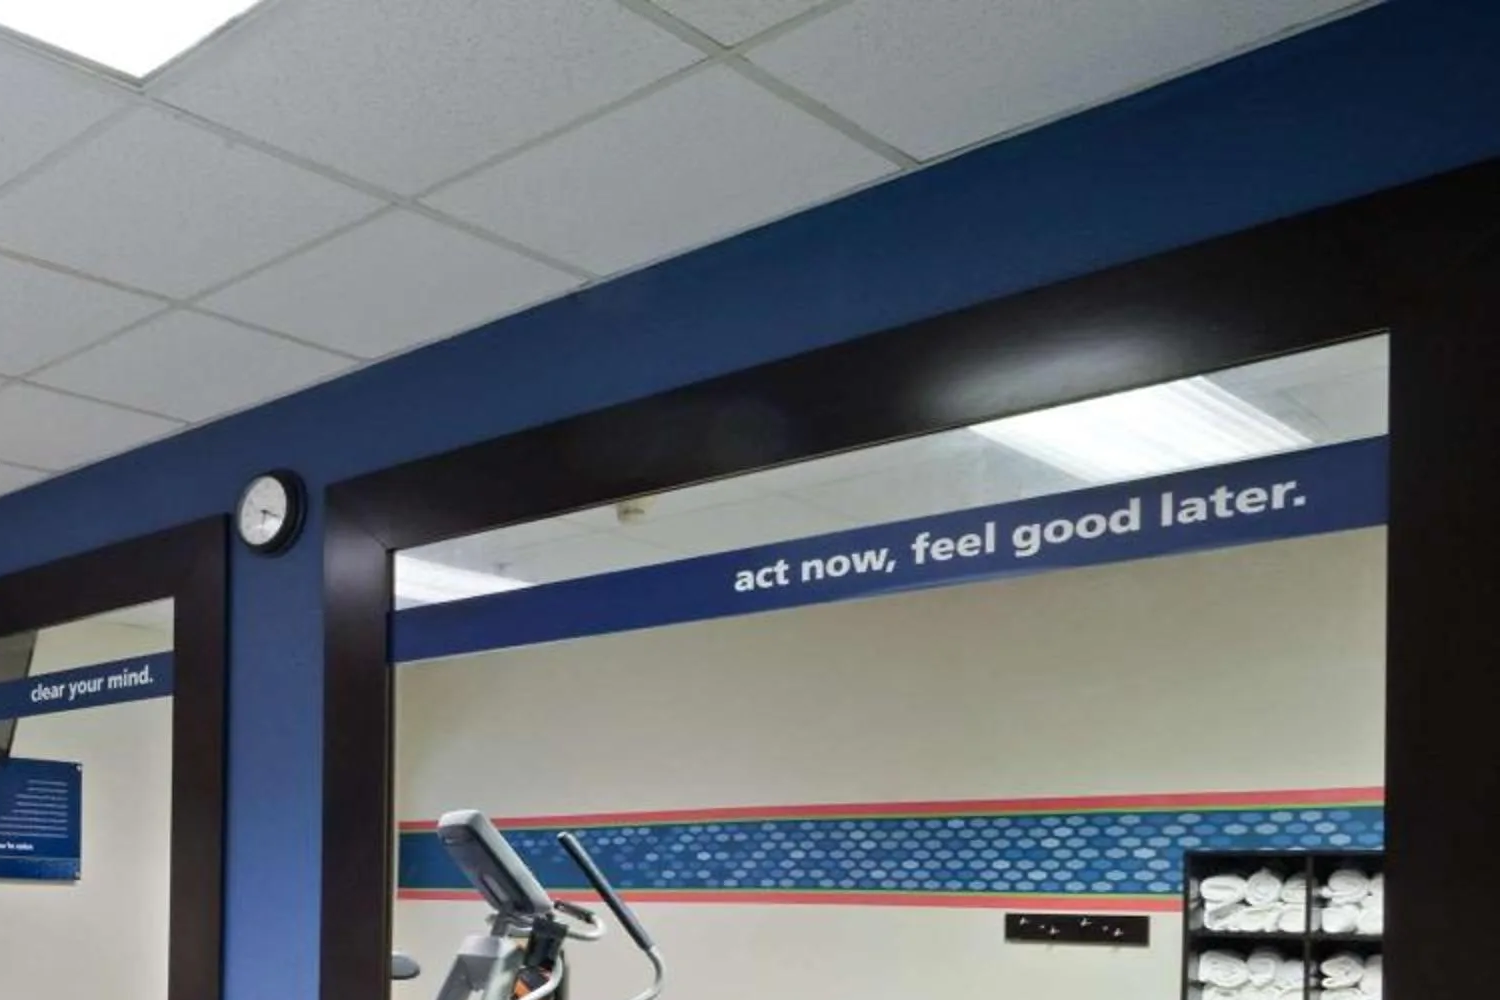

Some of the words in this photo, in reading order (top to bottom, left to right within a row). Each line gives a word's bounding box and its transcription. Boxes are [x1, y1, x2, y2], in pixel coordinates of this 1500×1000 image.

[733, 562, 790, 592] act
[801, 545, 896, 583] now,
[910, 521, 996, 566] feel
[1011, 497, 1141, 558] good
[1159, 479, 1306, 527] later.
[31, 683, 65, 702] clear
[68, 677, 104, 700] your
[107, 664, 153, 689] mind.
